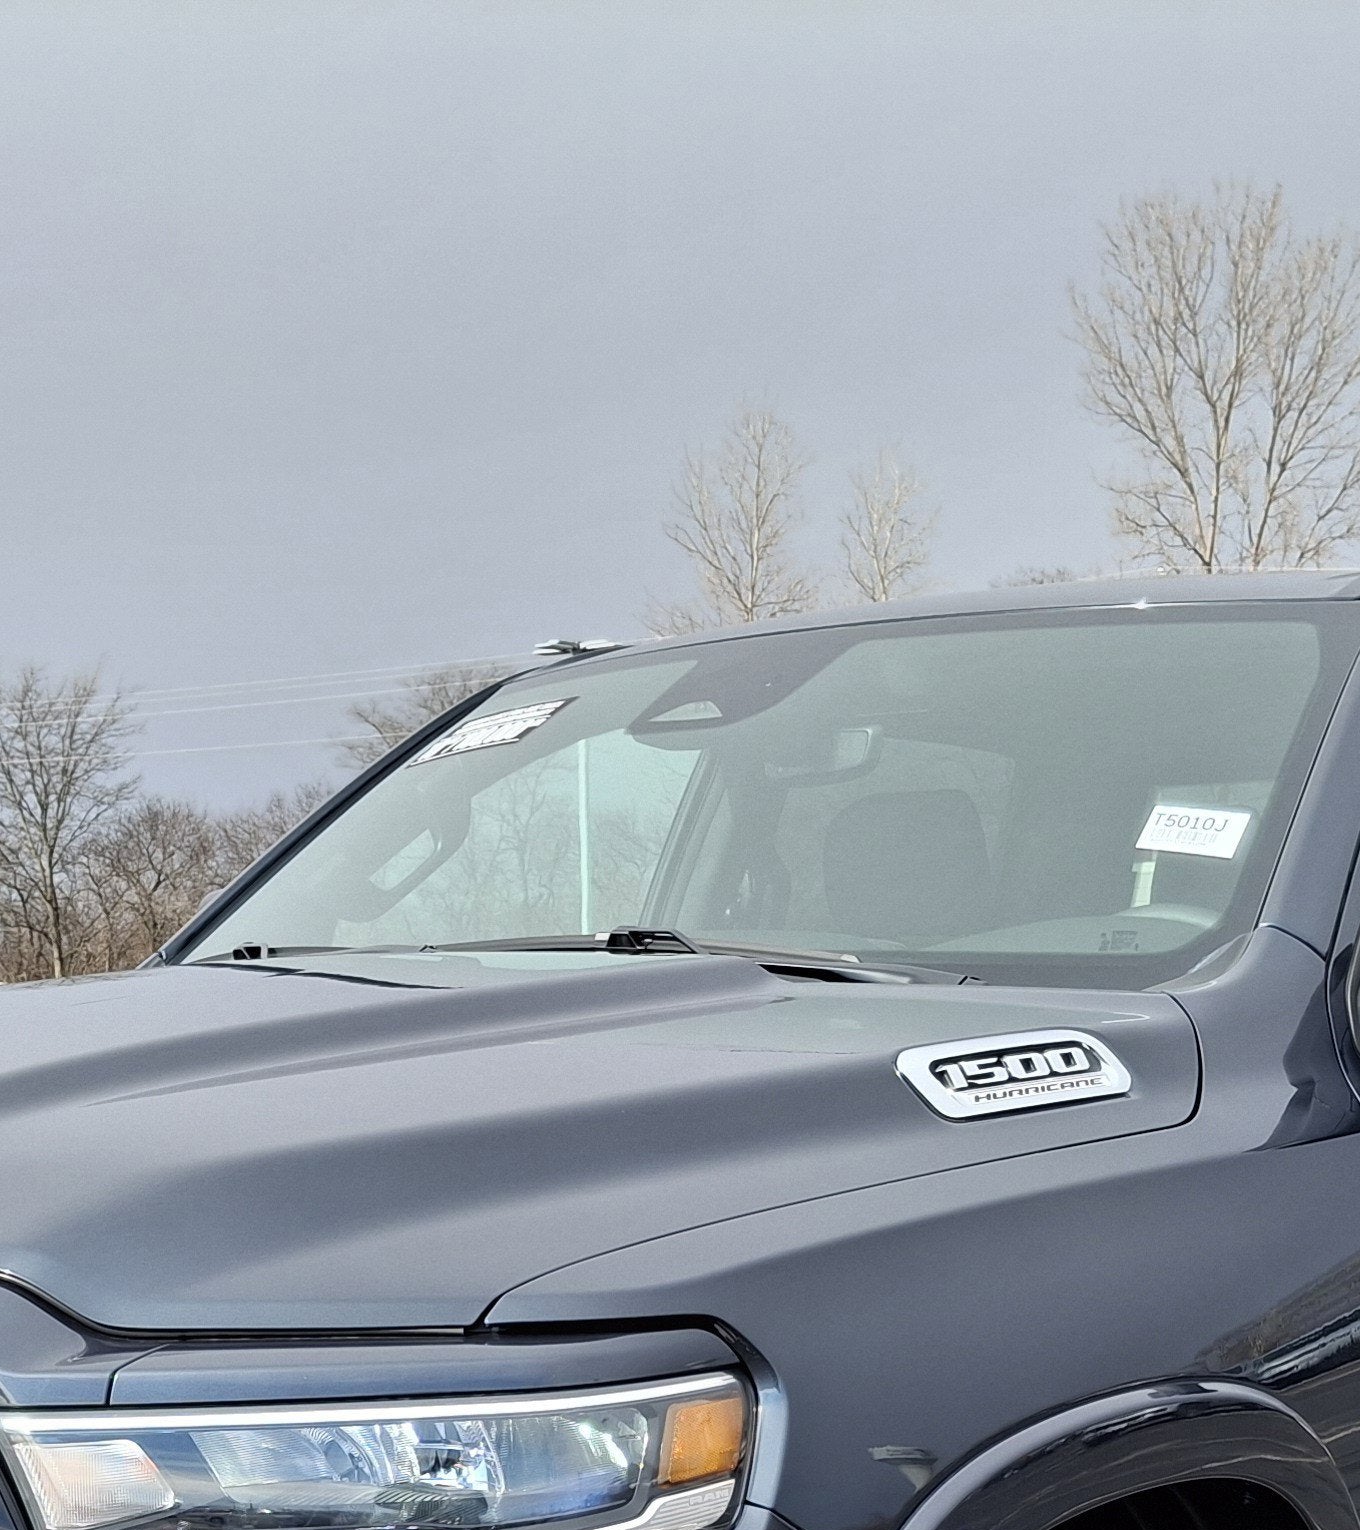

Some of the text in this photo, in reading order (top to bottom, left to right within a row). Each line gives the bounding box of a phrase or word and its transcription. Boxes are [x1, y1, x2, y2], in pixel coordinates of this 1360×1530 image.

[1154, 813, 1229, 832] T5010J
[935, 1047, 1091, 1091] 1500
[974, 1077, 1103, 1103] HURRICANE
[688, 1488, 731, 1507] RAM
